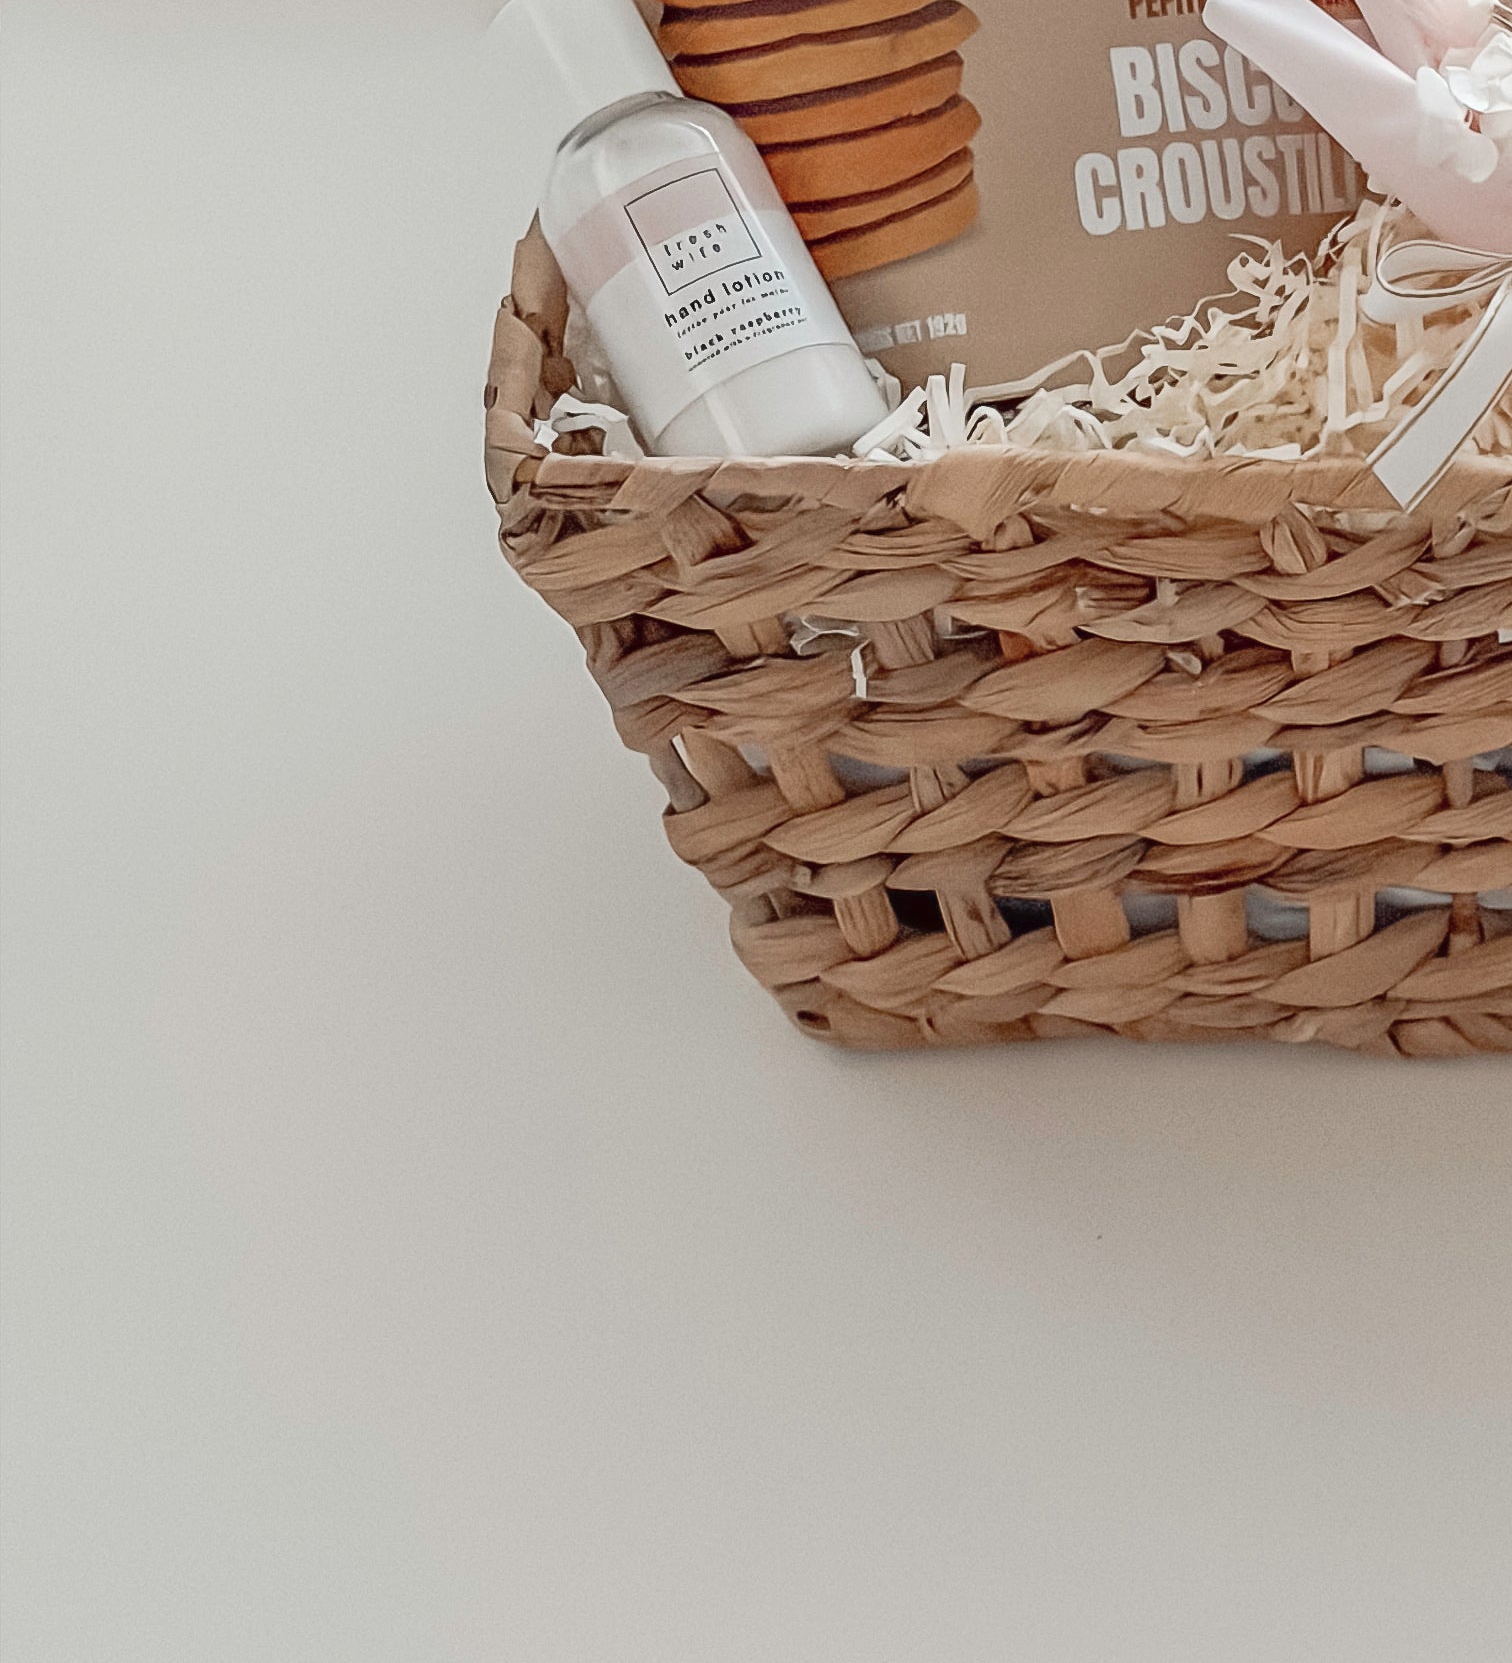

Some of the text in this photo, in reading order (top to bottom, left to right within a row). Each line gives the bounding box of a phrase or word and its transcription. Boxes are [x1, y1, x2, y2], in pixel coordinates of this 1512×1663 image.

[663, 223, 727, 256] fresh
[671, 243, 721, 271] wife
[664, 270, 785, 327] hand lotion
[684, 333, 724, 360] black
[730, 306, 801, 335] raspberry
